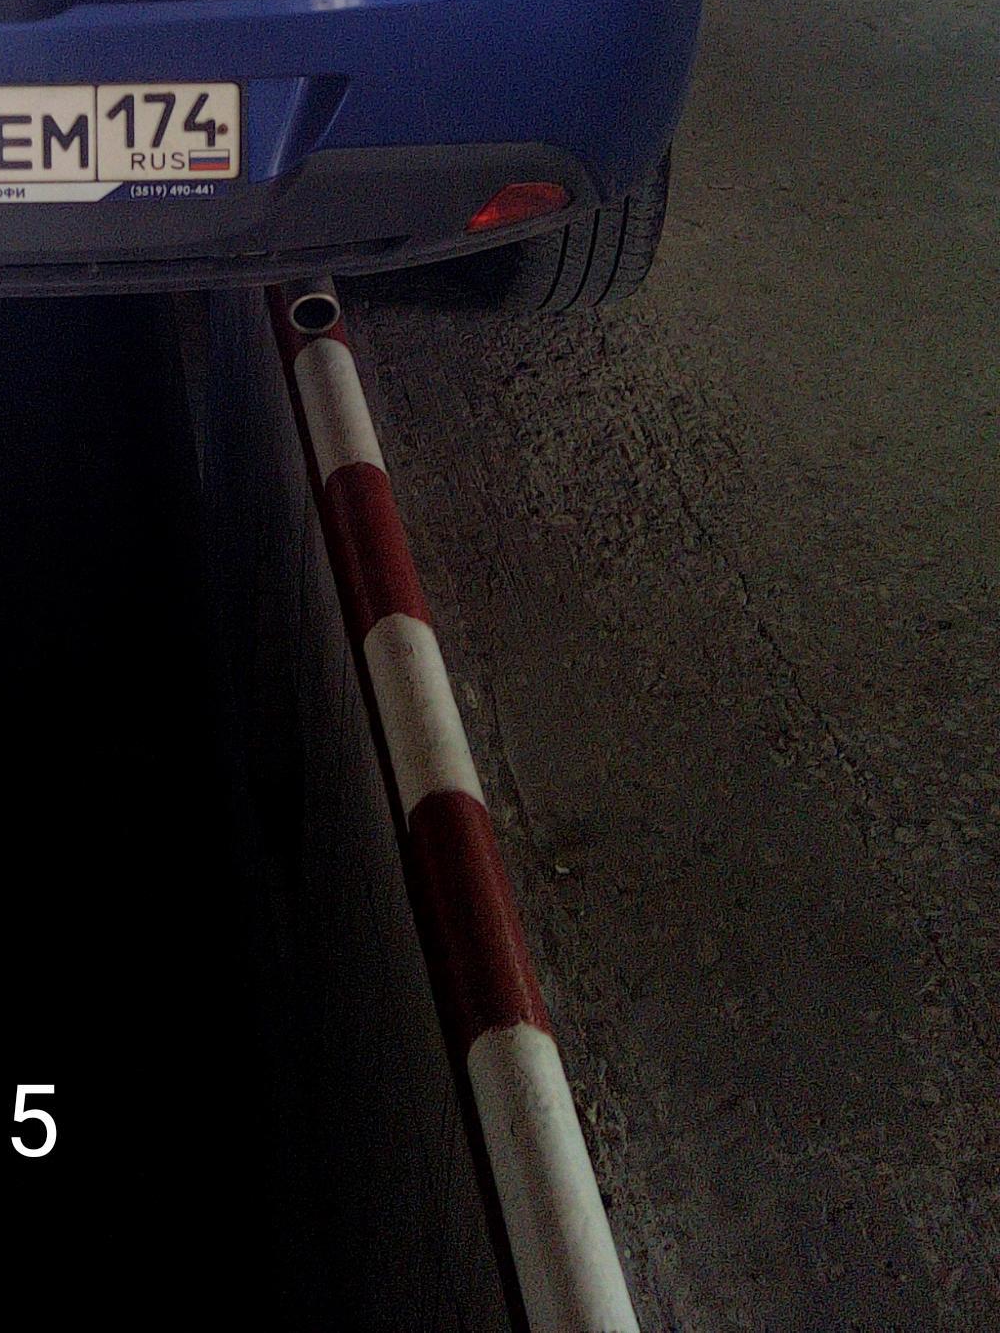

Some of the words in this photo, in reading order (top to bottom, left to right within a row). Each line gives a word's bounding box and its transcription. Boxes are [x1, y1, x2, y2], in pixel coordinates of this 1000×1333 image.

[106, 92, 216, 149] 174
[131, 152, 186, 171] RUS
[130, 185, 167, 198] (3519)
[170, 185, 215, 197] 490-441
